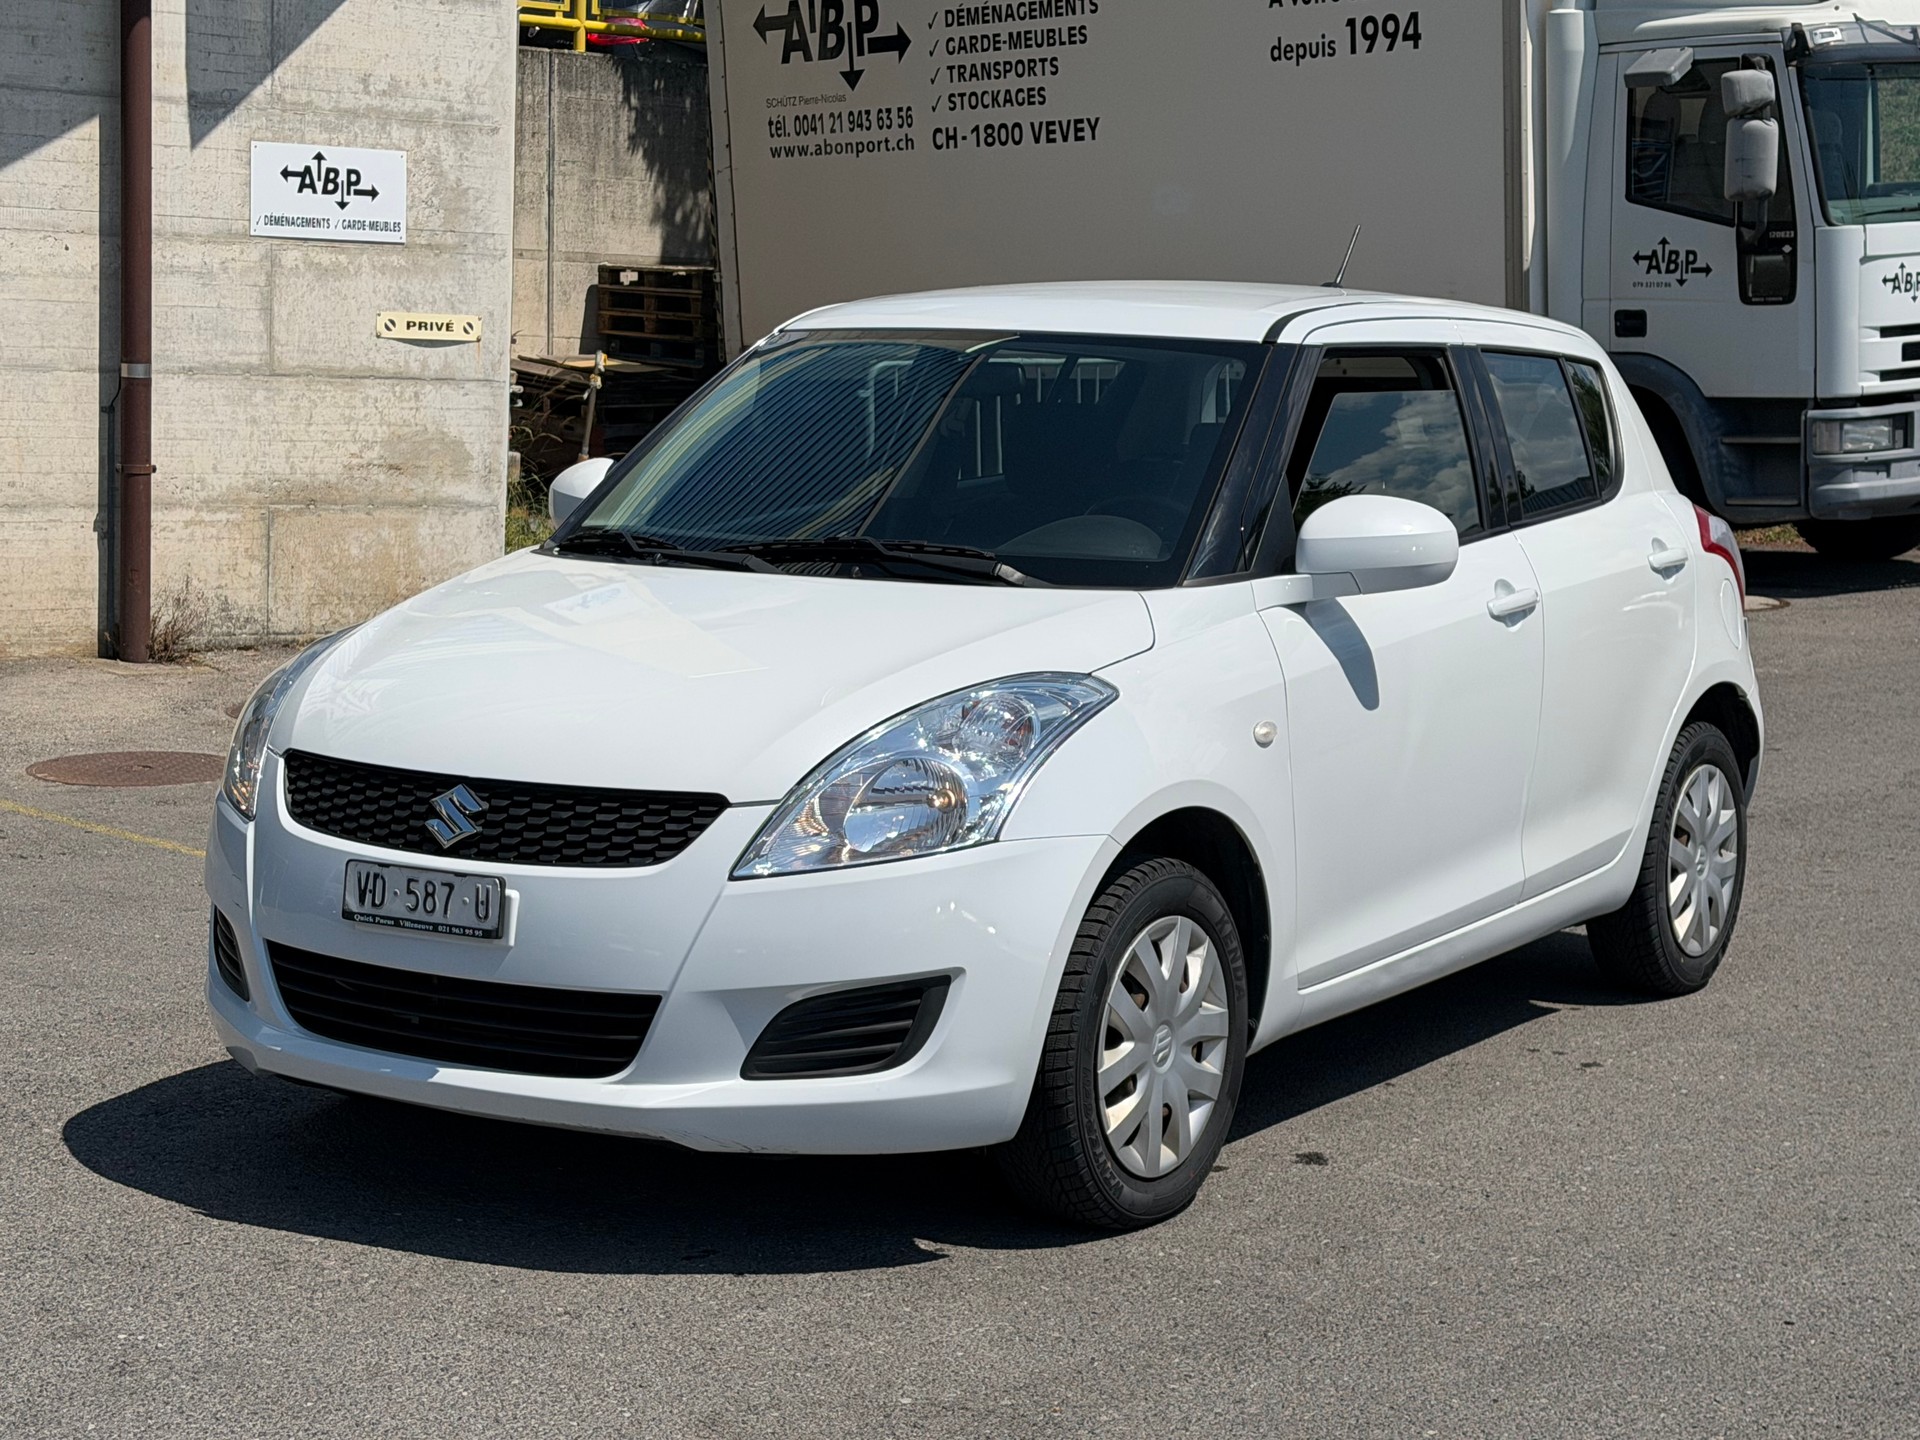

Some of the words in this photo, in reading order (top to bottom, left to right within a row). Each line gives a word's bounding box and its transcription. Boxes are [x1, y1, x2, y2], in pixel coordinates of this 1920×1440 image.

[944, 0, 1099, 28] DÉMÉNAGEMENTS
[781, 0, 879, 64] ABP
[945, 25, 1088, 56] GARDE-MEUBLES
[1270, 33, 1337, 67] depuis
[1345, 11, 1422, 55] 1994
[946, 56, 1060, 84] TRANSPORTS
[798, 93, 847, 106] Pierre-Nicolas
[947, 86, 1047, 112] STOCKAGES
[768, 114, 791, 139] tél.
[793, 112, 825, 137] 0041
[828, 111, 844, 134] 21
[847, 109, 872, 133] 943
[876, 107, 893, 131] 63
[896, 105, 914, 129] 56
[1029, 116, 1101, 145] VEVEY
[769, 133, 915, 159] www.abonport.ch
[297, 165, 362, 197] ABP
[263, 212, 331, 230] DÉMÉNAGEMENTS
[341, 218, 402, 233] GARDE-MEUBLES
[1645, 248, 1698, 275] ABP
[405, 319, 455, 333] PRIVÉ
[405, 877, 455, 920] 587
[474, 883, 492, 923] U
[354, 913, 374, 923] Quick
[375, 916, 395, 926] Pneus
[399, 920, 434, 931] Villeneuve
[1214, 913, 1247, 1002] KENDA
